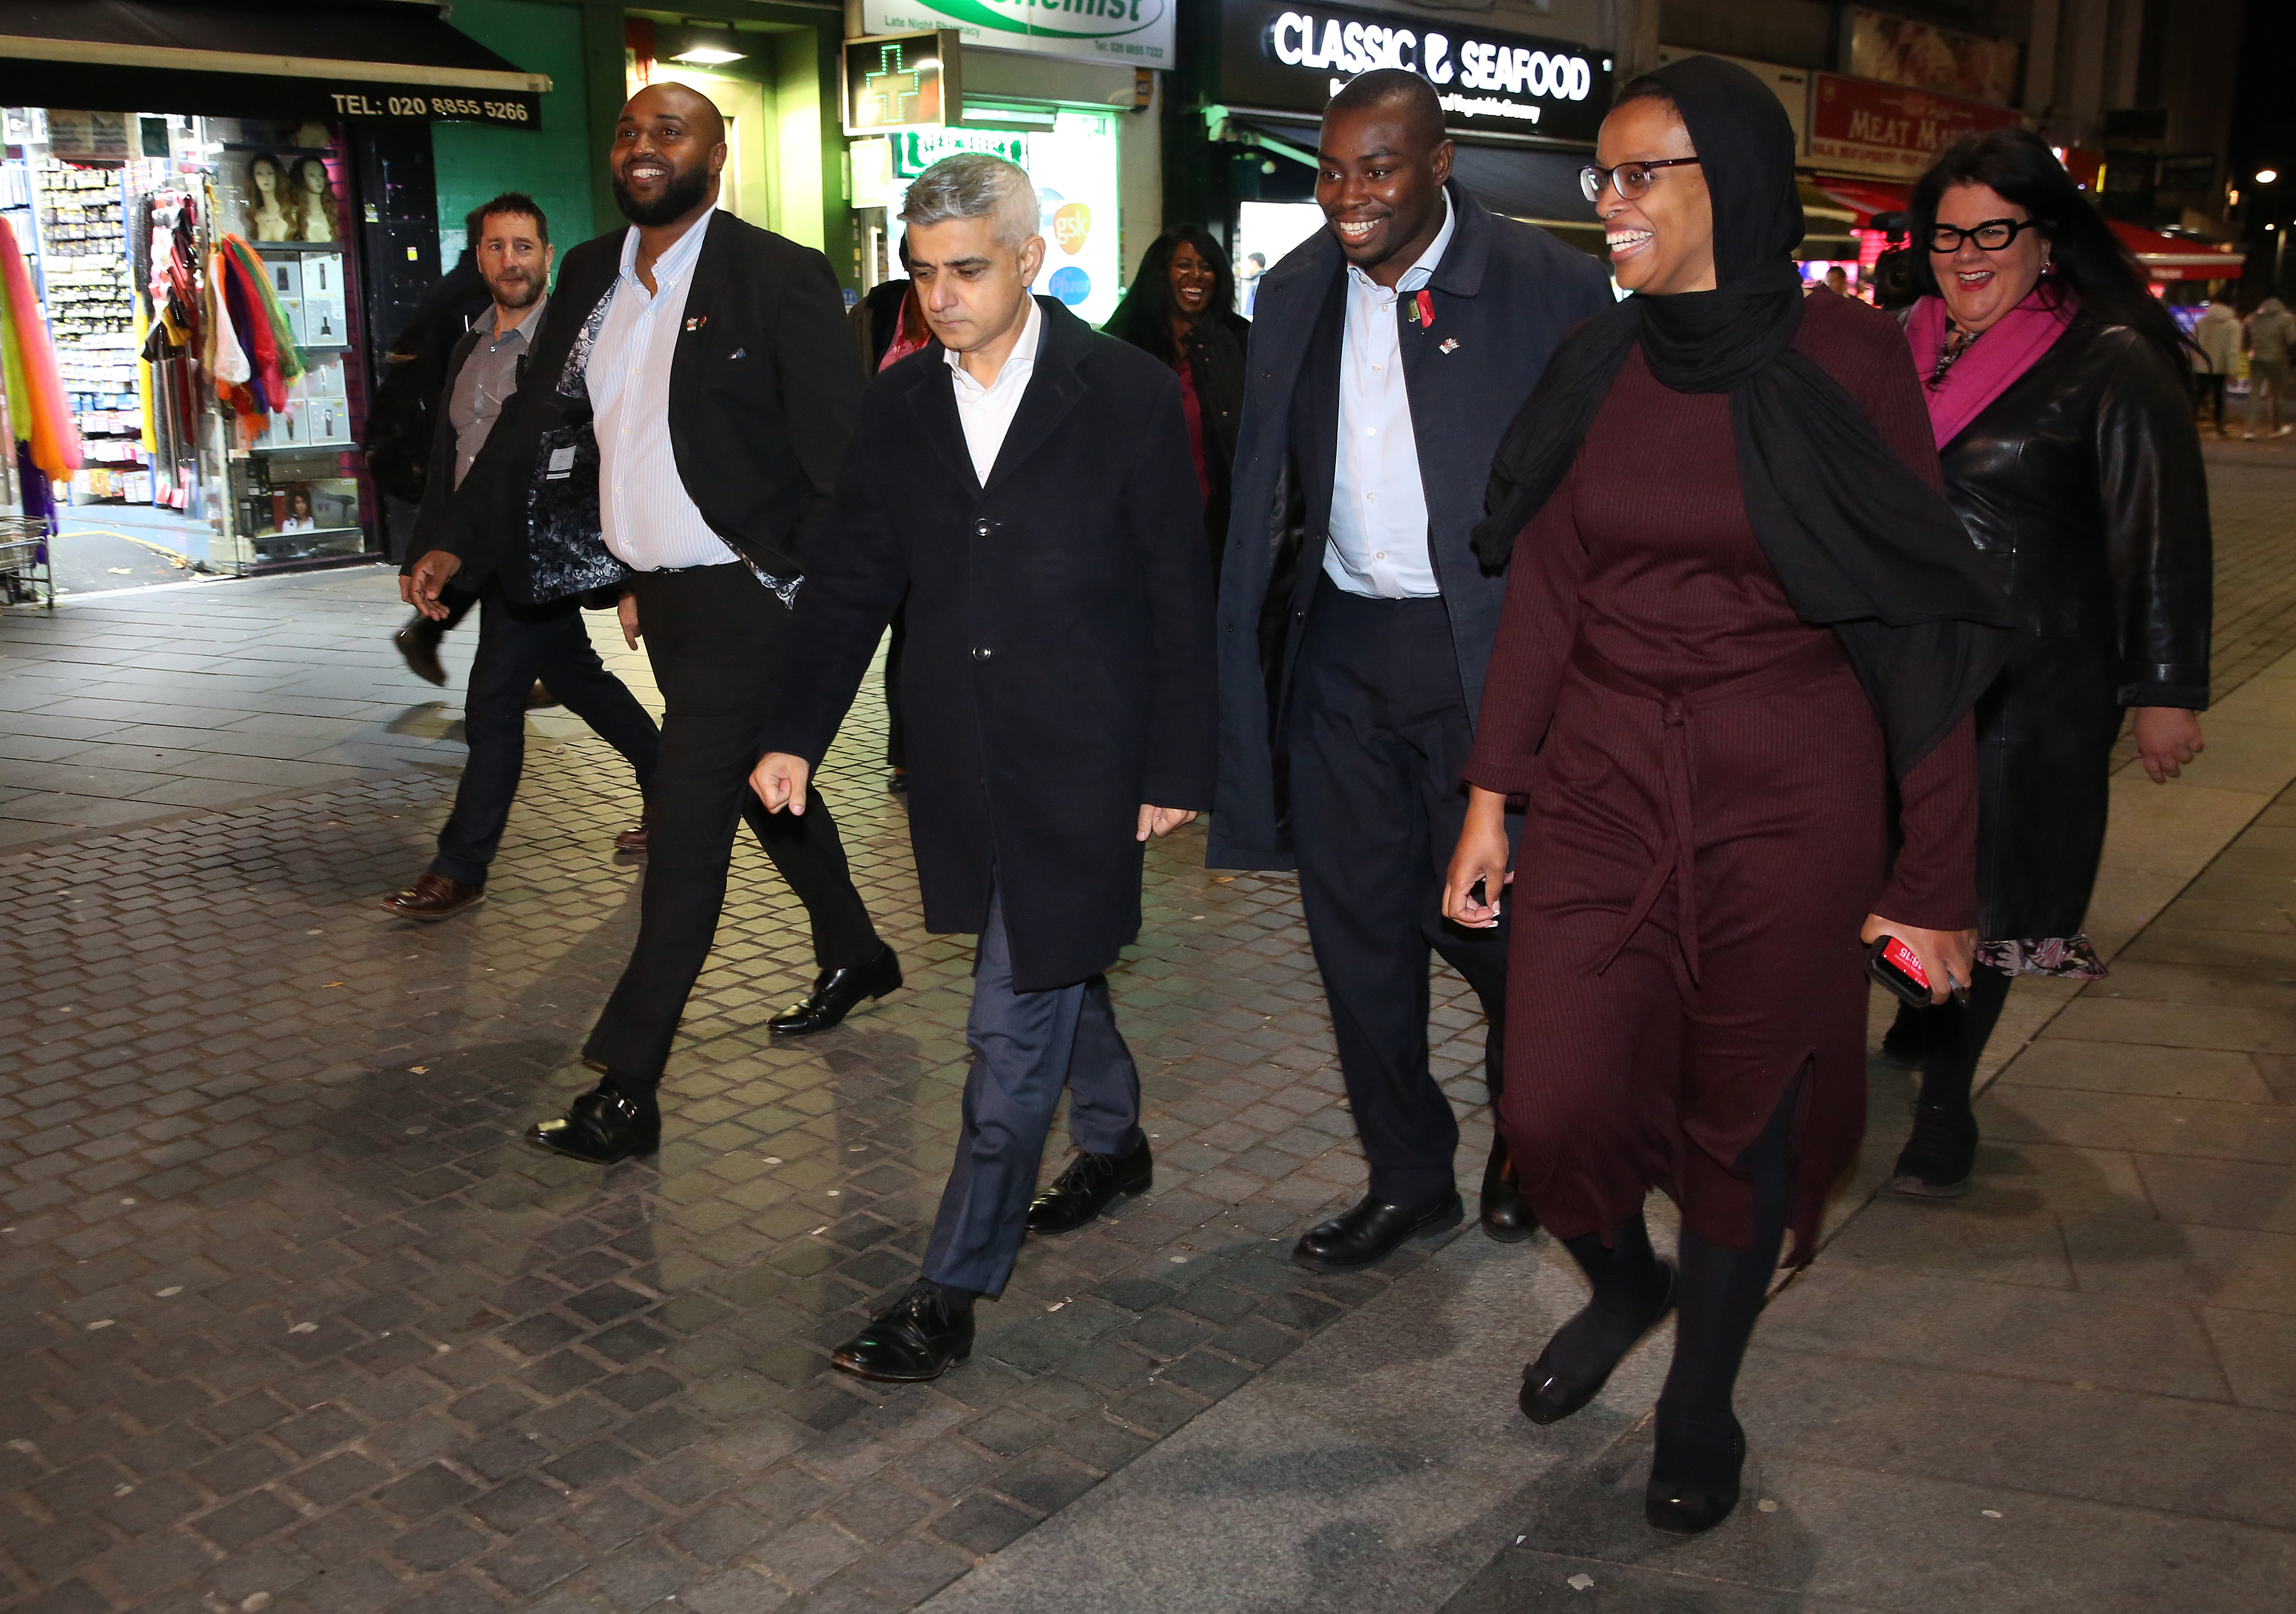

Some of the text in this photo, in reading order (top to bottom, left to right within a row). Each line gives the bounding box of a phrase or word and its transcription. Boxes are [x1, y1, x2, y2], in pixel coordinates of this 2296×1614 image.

[884, 15, 905, 27] Late
[908, 18, 933, 30] Night
[1274, 12, 1590, 101] CLASSIC SEAFOOD
[331, 94, 529, 121] TEL: 020 8855 5266
[1848, 109, 1911, 146] MEAT
[1056, 210, 1088, 245] gsk
[1052, 269, 1089, 300] Pfizer
